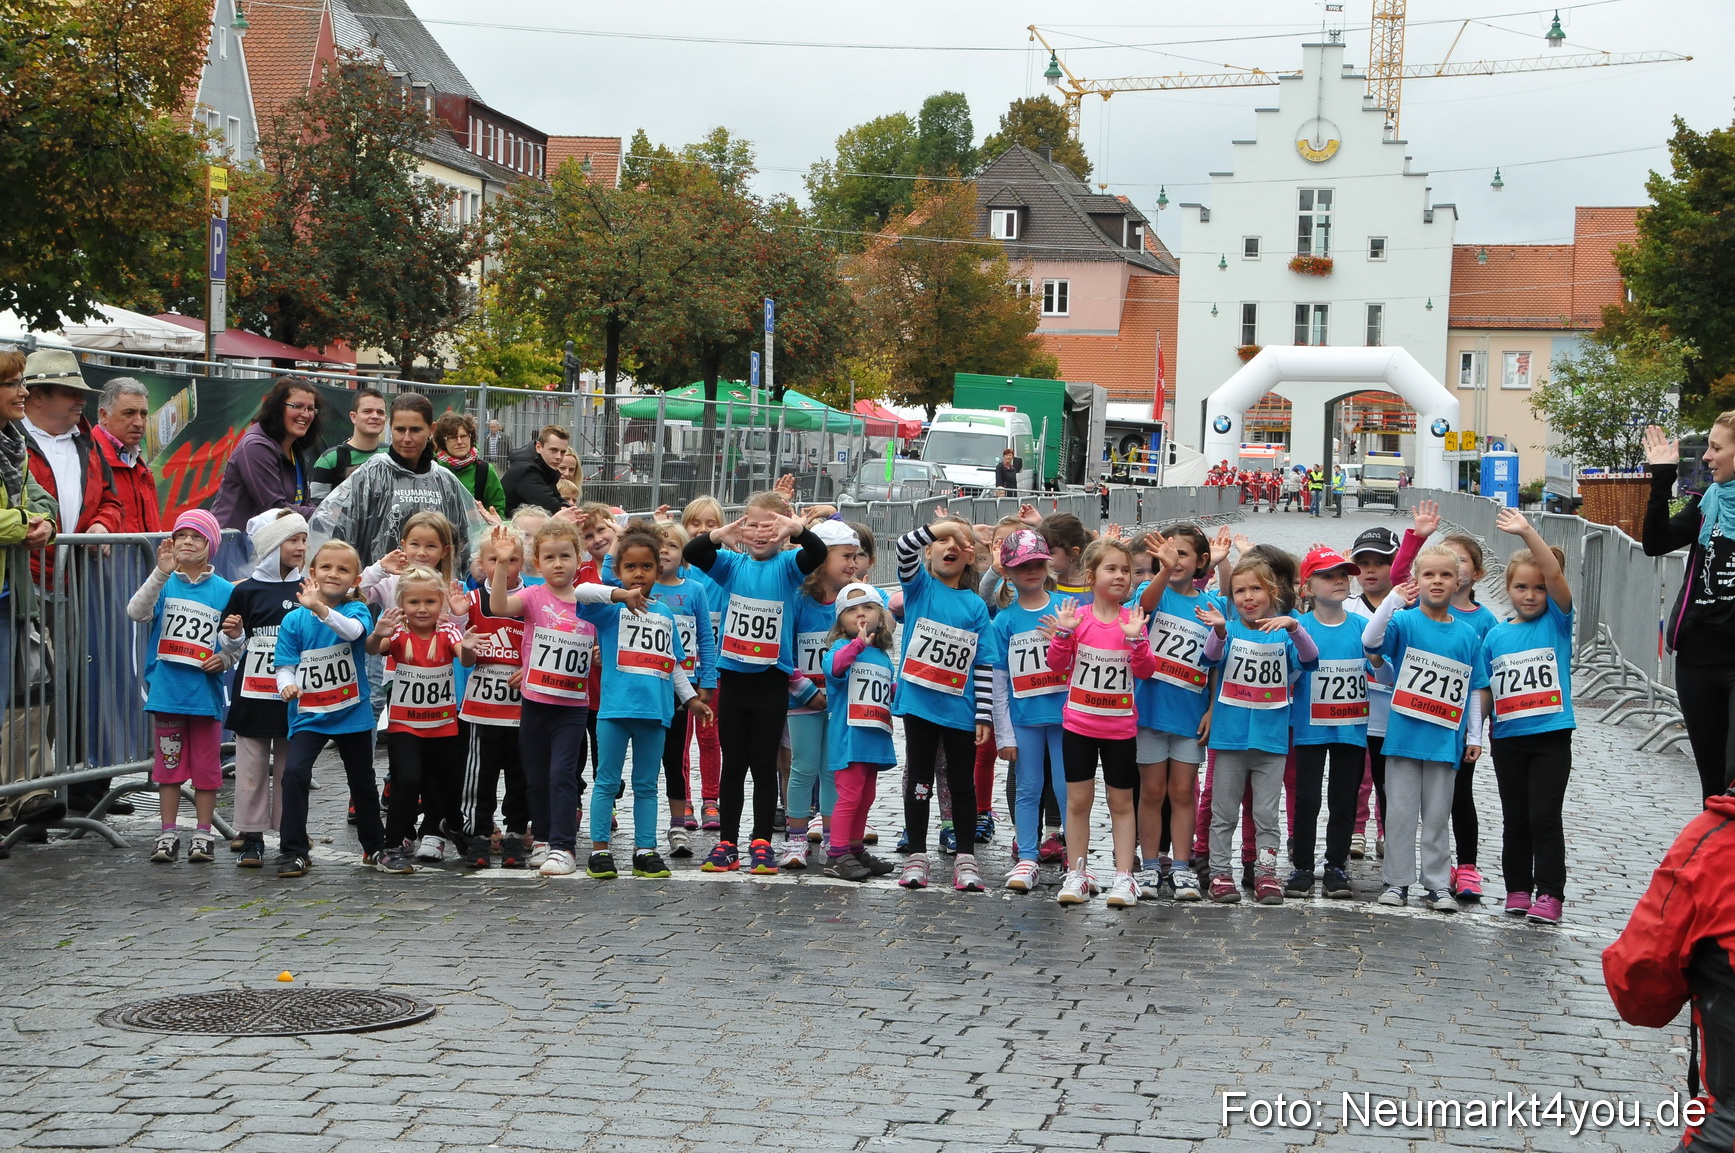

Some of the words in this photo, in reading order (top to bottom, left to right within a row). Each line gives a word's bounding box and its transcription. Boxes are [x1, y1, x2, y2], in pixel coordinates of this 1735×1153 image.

[213, 226, 223, 271] P
[766, 303, 772, 328] P
[752, 357, 758, 381] P
[840, 453, 845, 461] P
[399, 496, 442, 505] STADTLAUF
[181, 606, 212, 619] Neumarkt
[743, 604, 775, 613] Neumarkt
[165, 614, 214, 645] 7232
[730, 610, 777, 640] 7595
[534, 632, 557, 643] PARTL
[557, 637, 588, 648] Neumarkt
[627, 624, 672, 656] 7502
[940, 631, 969, 643] Neumarkt
[168, 643, 195, 656] Hanna
[310, 651, 341, 663] Neumarkt
[477, 644, 519, 659] adidas
[538, 643, 589, 674] 7103
[917, 634, 971, 671] 7558
[1231, 645, 1249, 654] PARTL
[1405, 653, 1430, 666] PARTL
[1431, 660, 1462, 676] Neumarkt
[1510, 655, 1544, 666] Neumarkt
[300, 659, 351, 690] 7540
[395, 669, 415, 678] PARTL
[851, 667, 874, 675] PARTL
[1079, 660, 1127, 690] 7121
[1160, 661, 1190, 679] Emilia
[1232, 655, 1282, 685] 7588
[1030, 674, 1060, 687] Sophie
[1318, 674, 1366, 700] 7239
[1407, 665, 1464, 703] 7213
[1495, 664, 1552, 695] 7246
[399, 680, 451, 705] 7084
[1085, 693, 1117, 707] Sophie
[1330, 706, 1359, 718] Sophia
[1410, 697, 1447, 716] Carlotta
